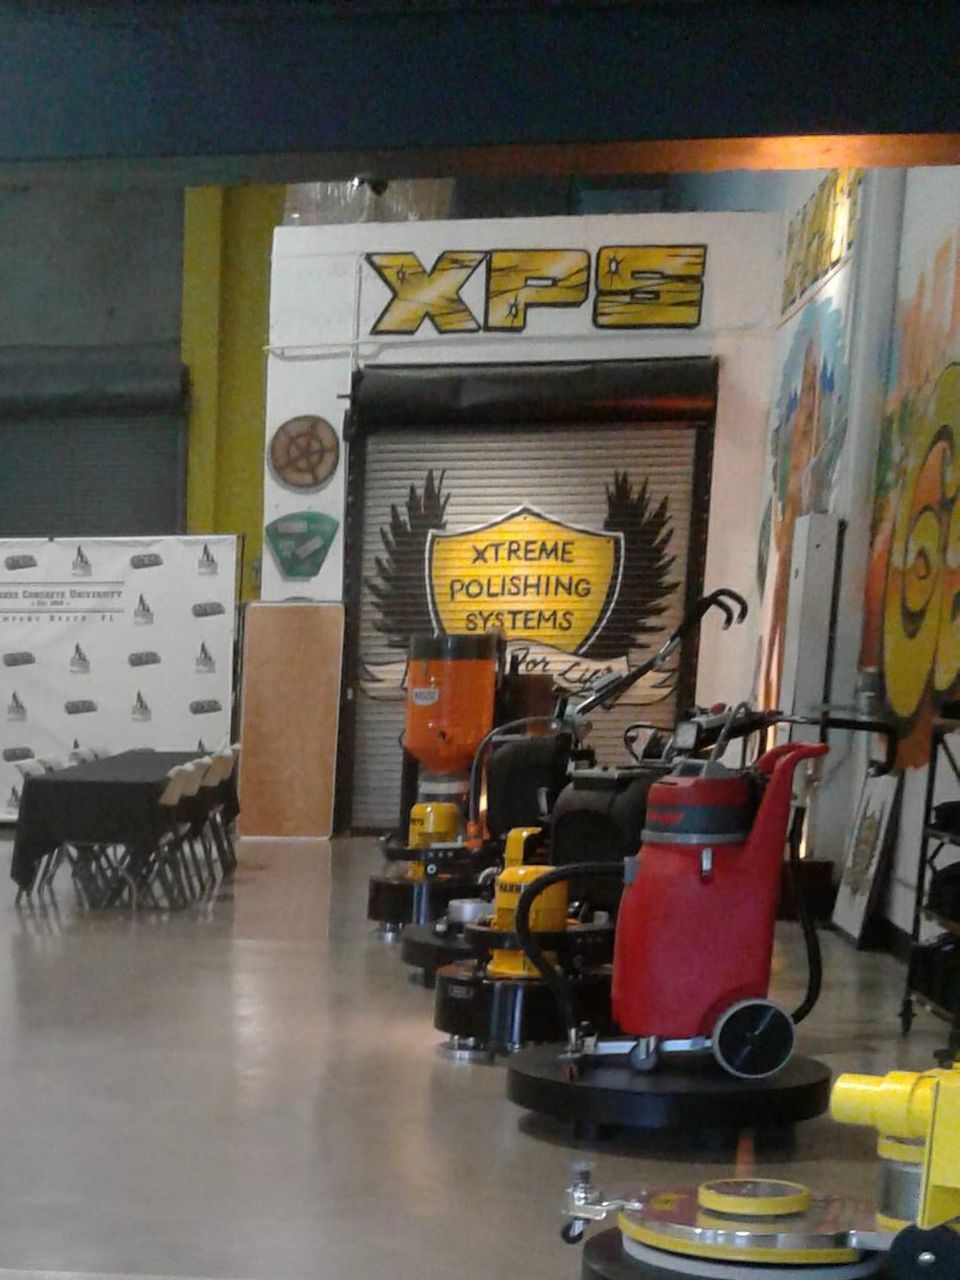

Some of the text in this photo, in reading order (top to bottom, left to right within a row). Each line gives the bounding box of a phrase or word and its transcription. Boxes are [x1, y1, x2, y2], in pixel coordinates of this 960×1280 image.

[364, 243, 708, 334] XPS
[471, 539, 576, 565] XTREME
[448, 574, 592, 601] POLISHING
[465, 608, 575, 632] SYSTEMS
